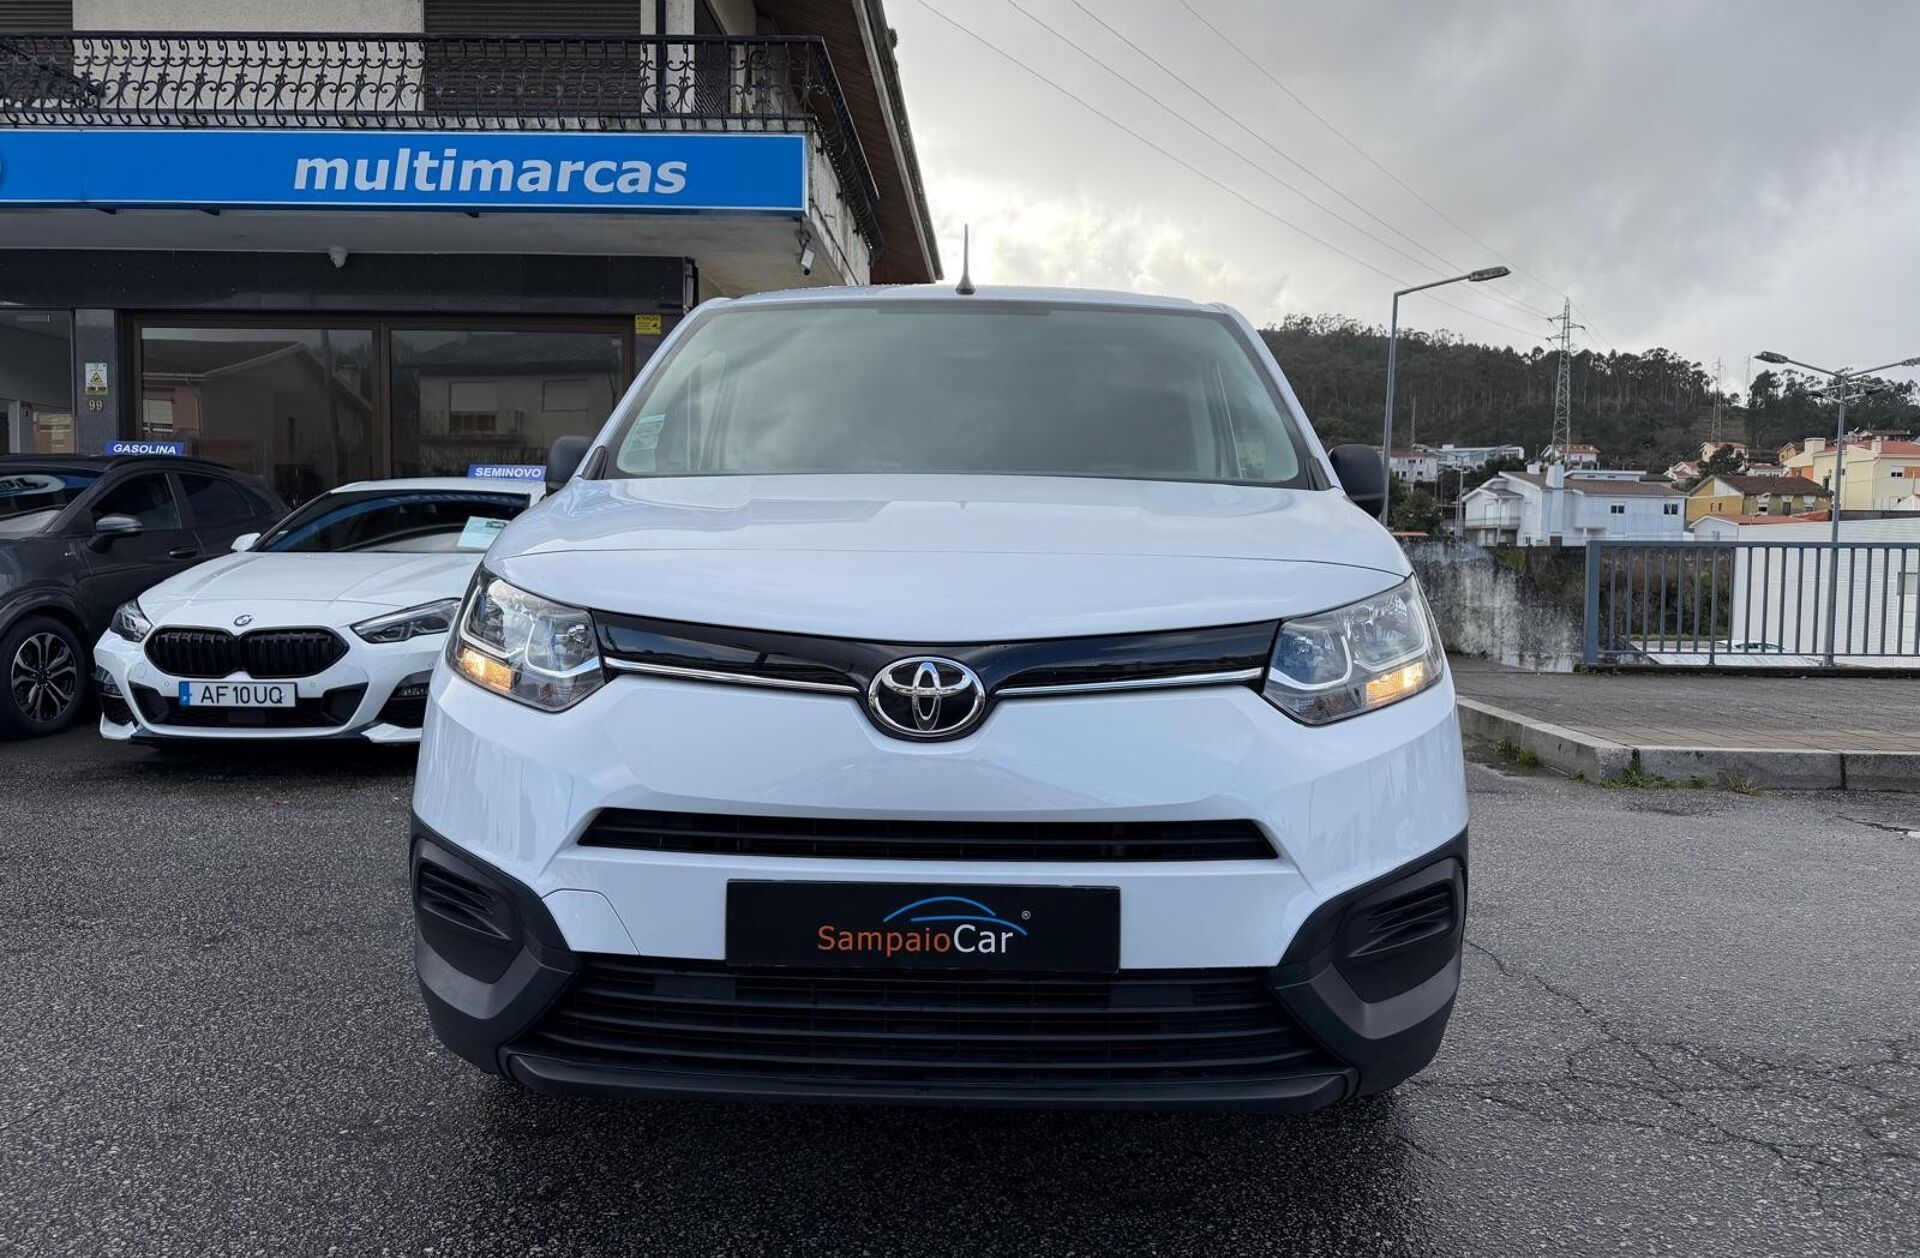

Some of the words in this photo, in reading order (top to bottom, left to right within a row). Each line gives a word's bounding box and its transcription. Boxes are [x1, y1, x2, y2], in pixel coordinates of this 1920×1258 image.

[294, 148, 688, 194] multimarcas
[89, 400, 103, 410] 99
[113, 443, 176, 455] GASOLINA
[475, 467, 541, 478] SEMINOVO
[201, 686, 229, 704] AF
[817, 923, 1013, 957] SampaioCar
